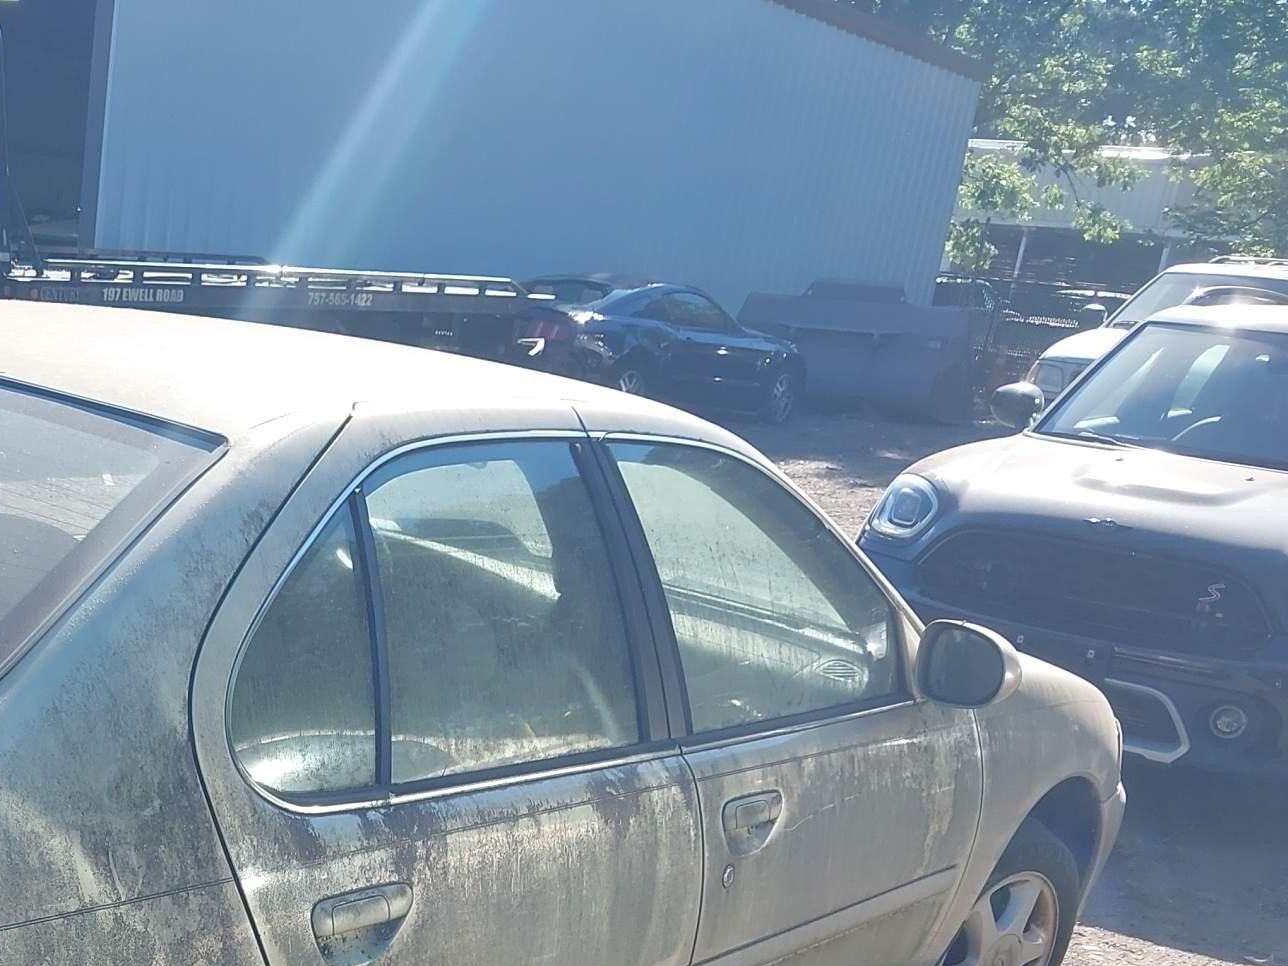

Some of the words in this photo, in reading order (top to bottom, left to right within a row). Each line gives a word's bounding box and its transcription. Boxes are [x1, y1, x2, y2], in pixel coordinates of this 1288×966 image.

[103, 287, 121, 302] 197
[122, 288, 154, 302] EWELL
[155, 288, 184, 303] ROAD
[307, 292, 373, 306] 757-565-1422
